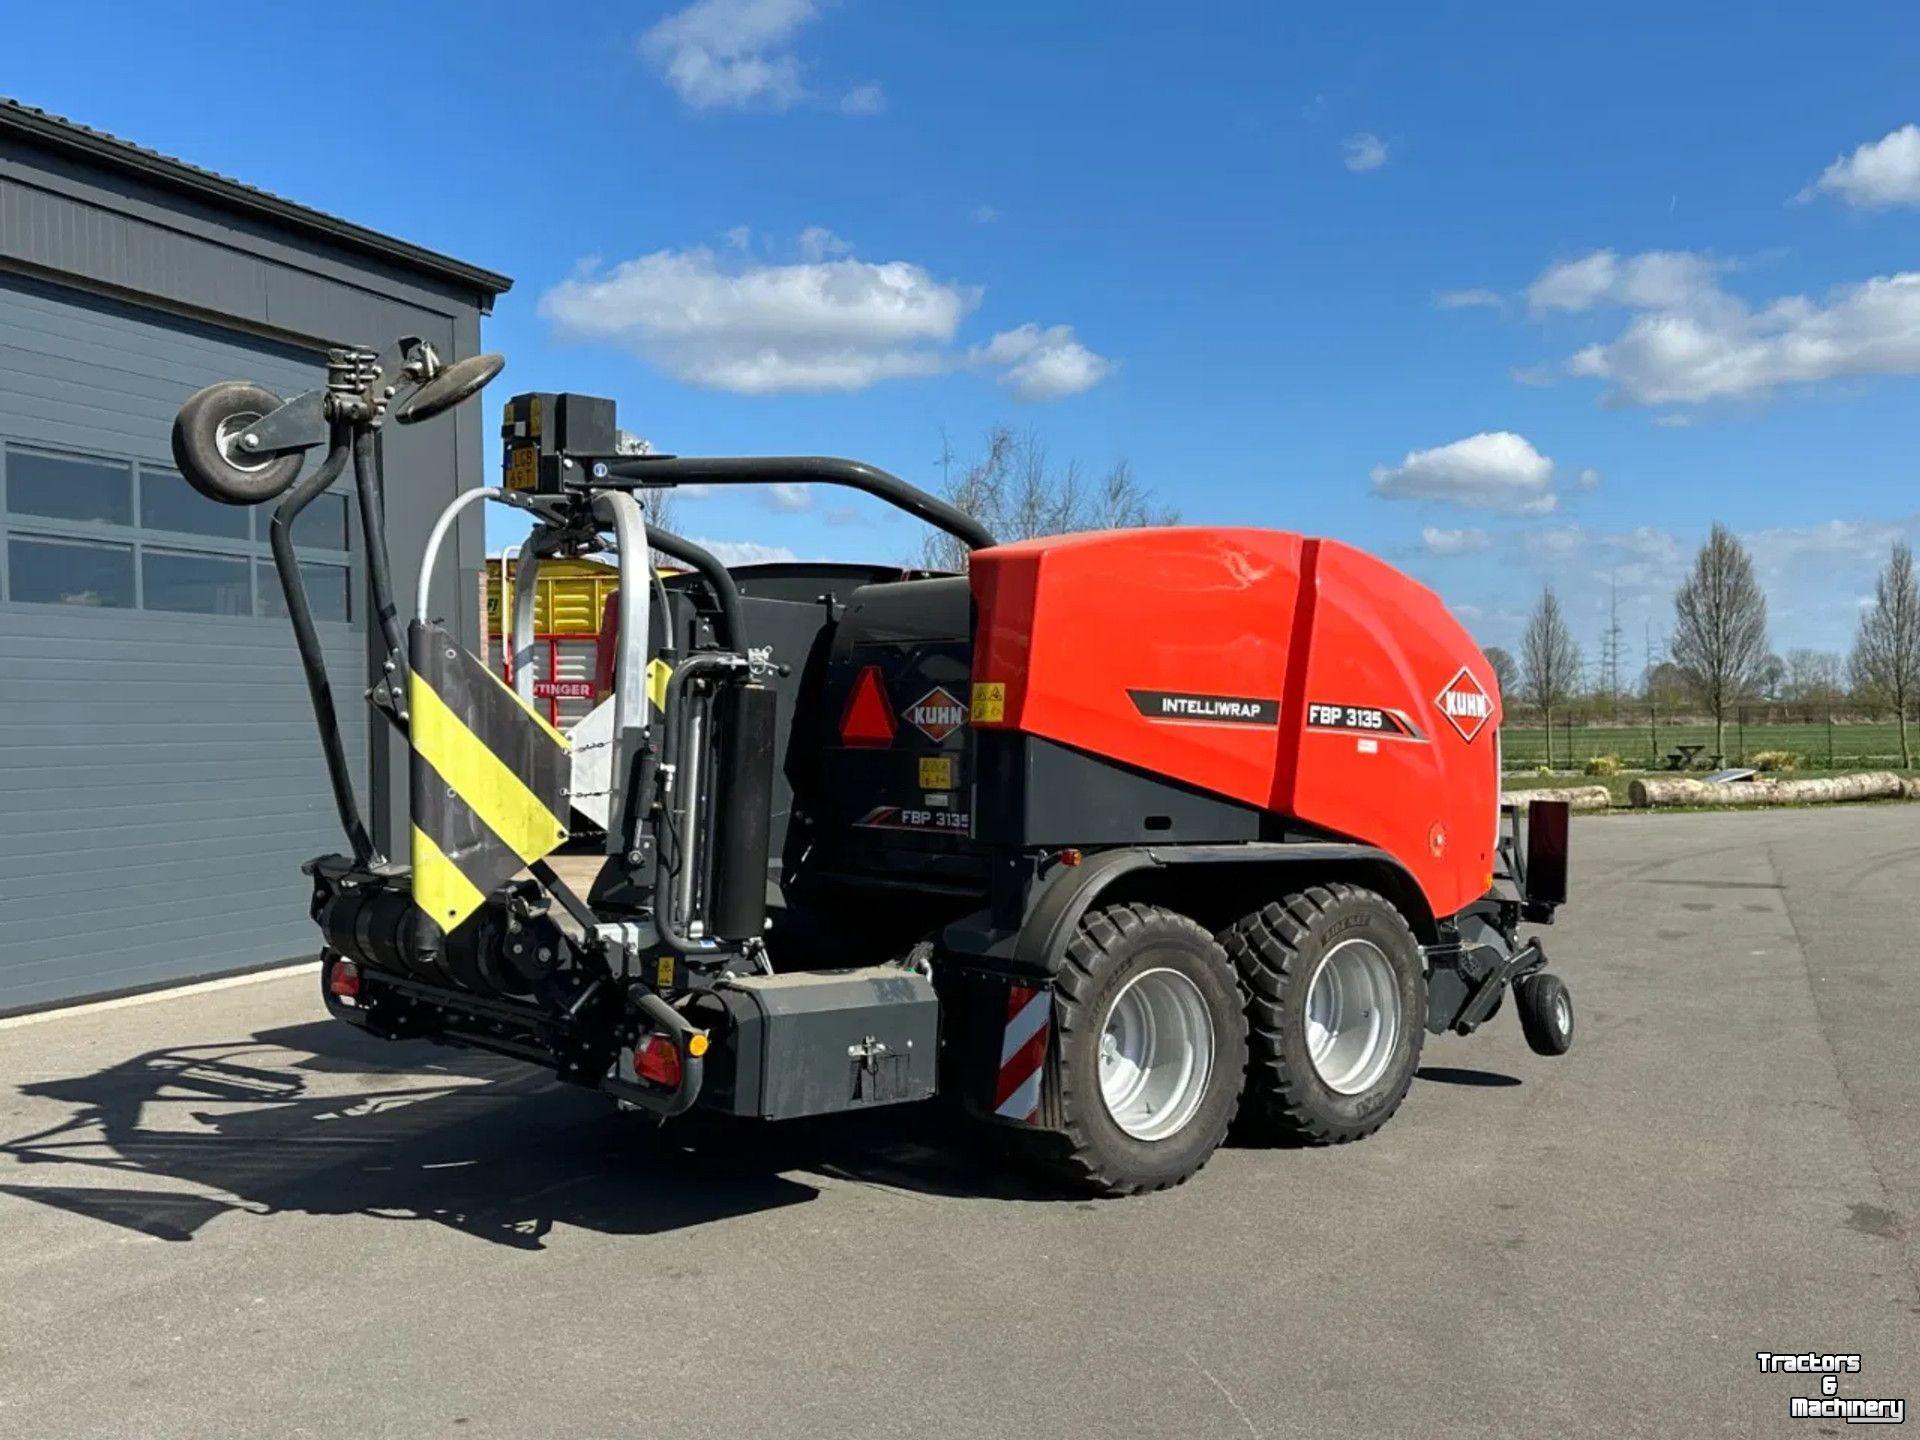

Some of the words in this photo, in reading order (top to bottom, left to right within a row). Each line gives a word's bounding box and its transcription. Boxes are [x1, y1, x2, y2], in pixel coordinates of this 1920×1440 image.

[1162, 697, 1261, 718] INTELLIWRAP
[1446, 691, 1487, 717] KUHN
[914, 706, 962, 725] KUHN
[1309, 705, 1342, 726] FBP
[1346, 708, 1382, 729] 3135
[901, 810, 931, 825] FBP
[936, 812, 969, 828] 3135
